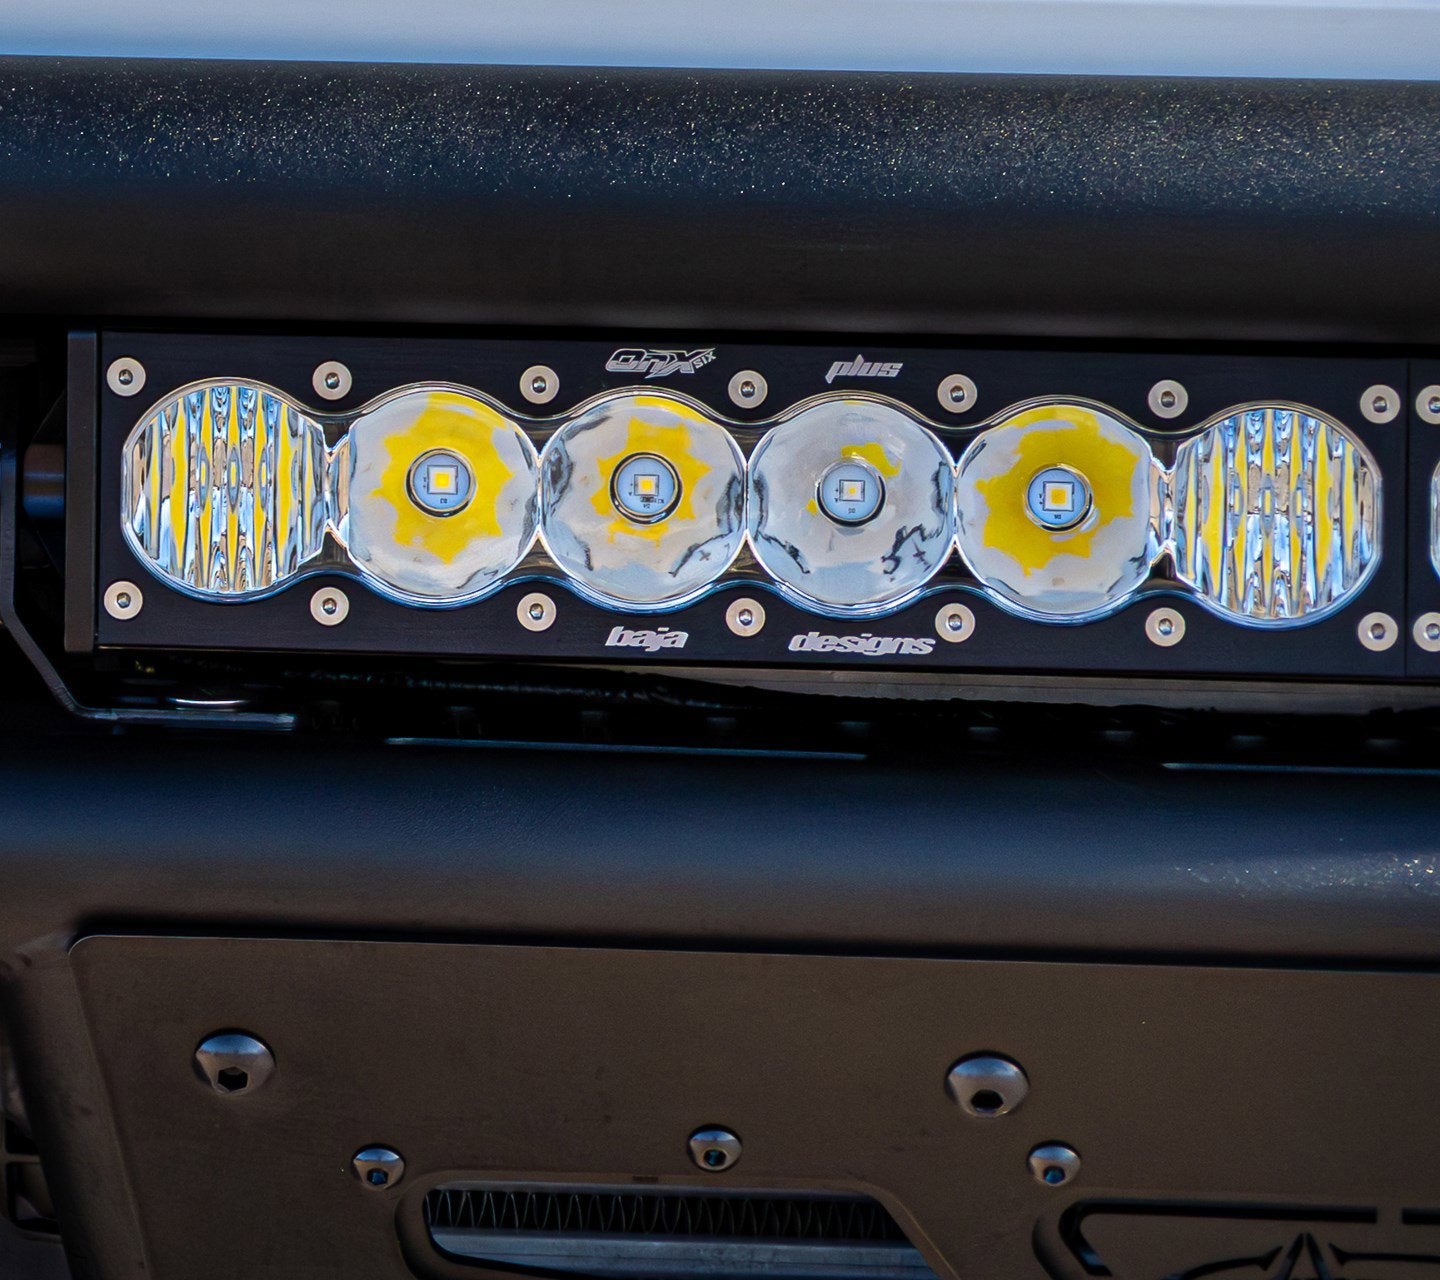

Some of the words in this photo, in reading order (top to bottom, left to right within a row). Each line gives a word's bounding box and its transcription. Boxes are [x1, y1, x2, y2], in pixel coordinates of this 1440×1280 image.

[824, 354, 904, 384] plus
[604, 625, 690, 652] baja
[787, 631, 936, 656] designs
